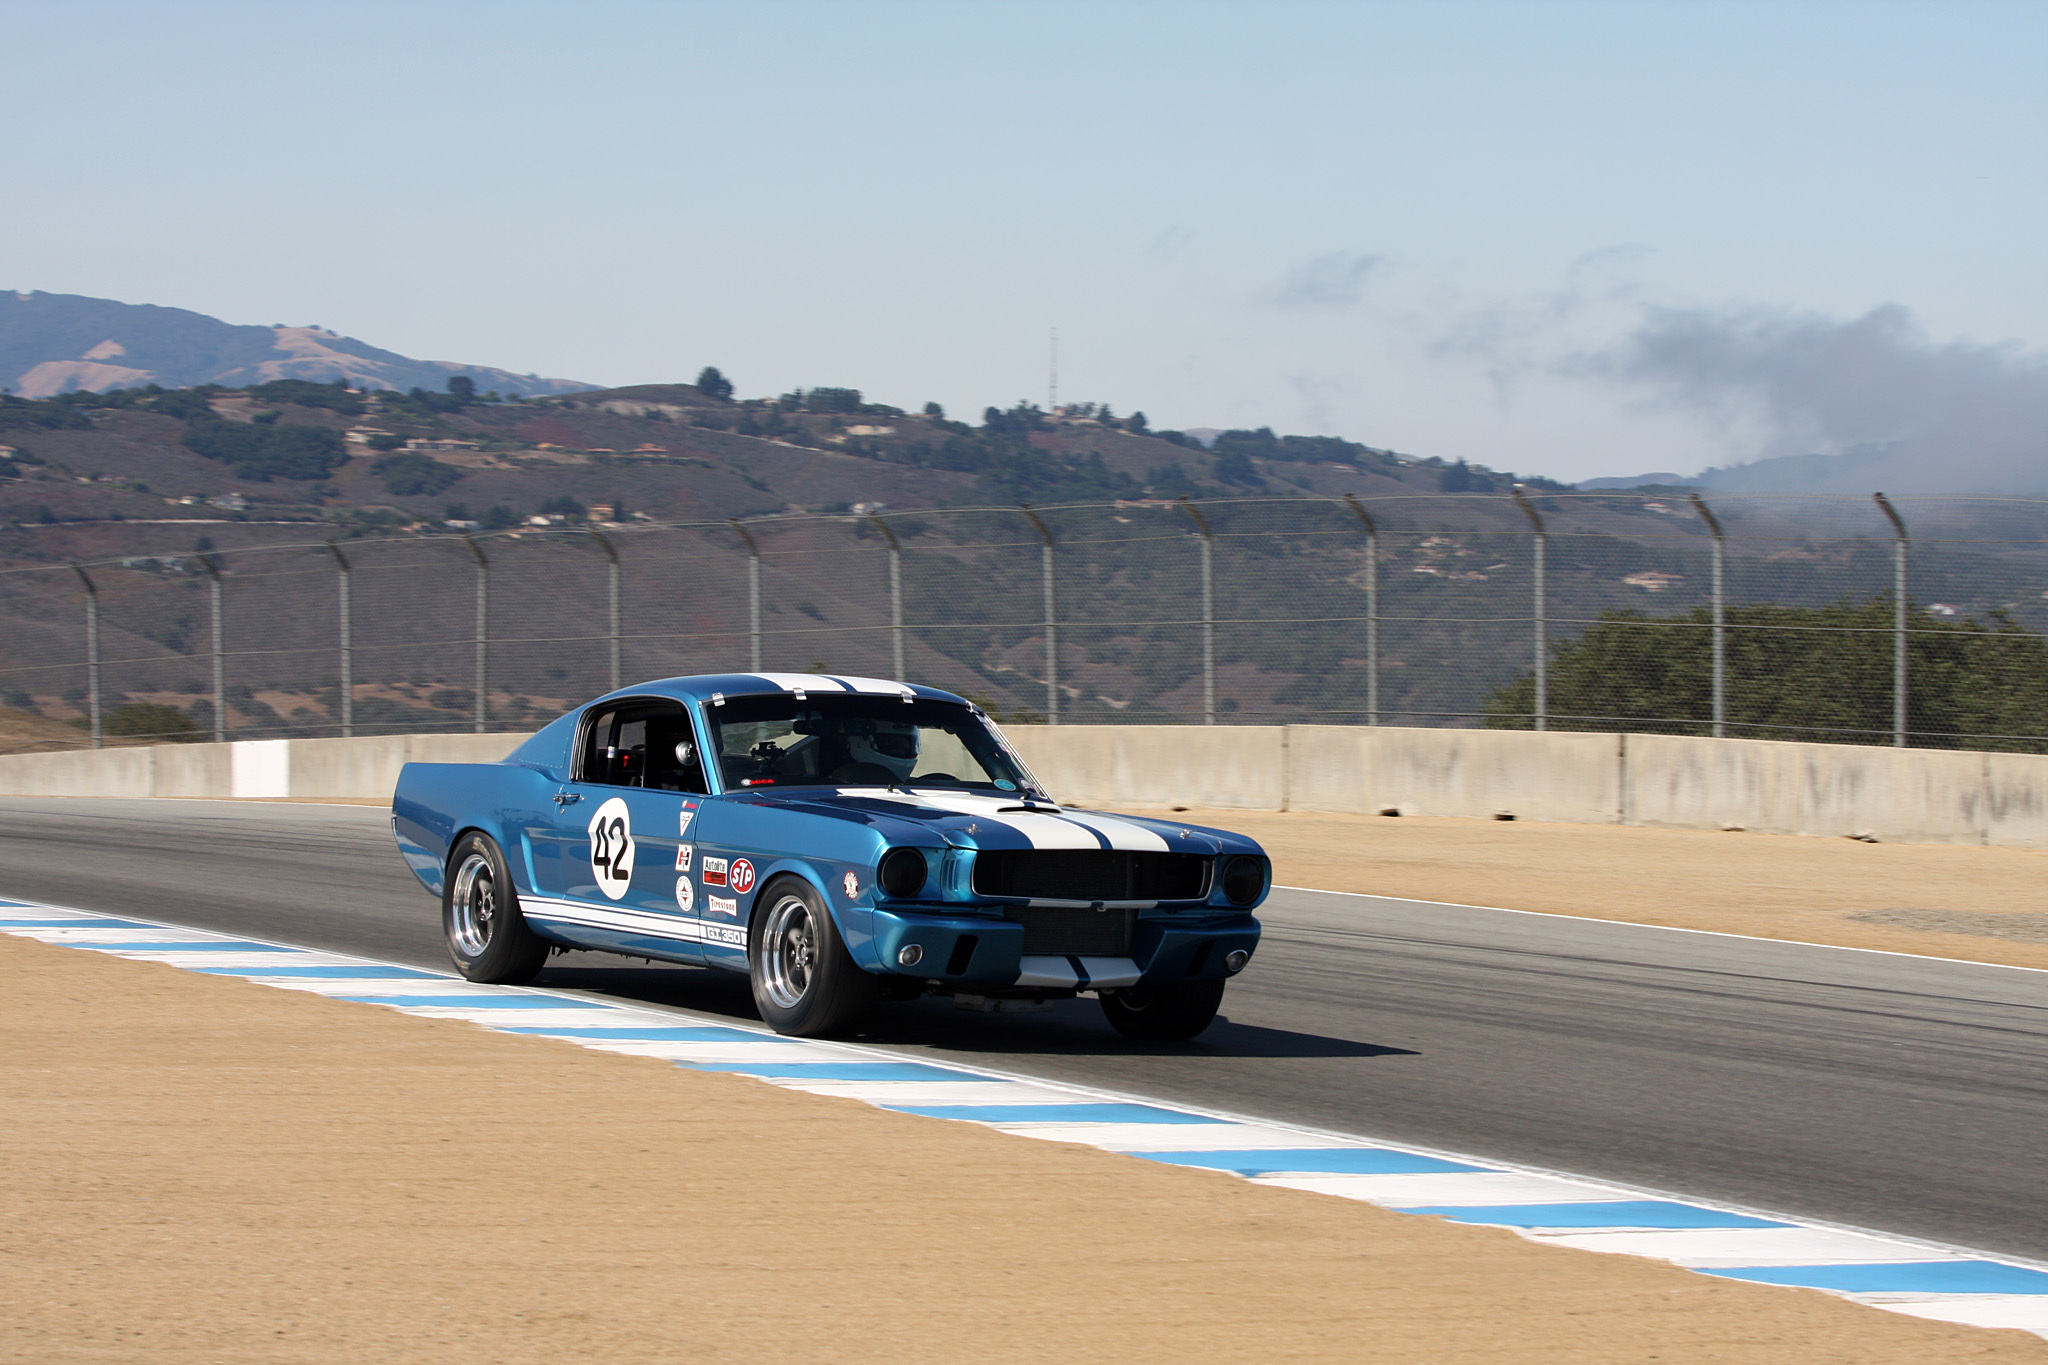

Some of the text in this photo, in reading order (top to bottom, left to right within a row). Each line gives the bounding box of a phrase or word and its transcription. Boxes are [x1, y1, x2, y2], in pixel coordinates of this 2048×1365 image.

[593, 815, 629, 880] 42
[704, 859, 726, 873] Autolite
[732, 862, 753, 888] STP
[710, 898, 735, 912] Firestone
